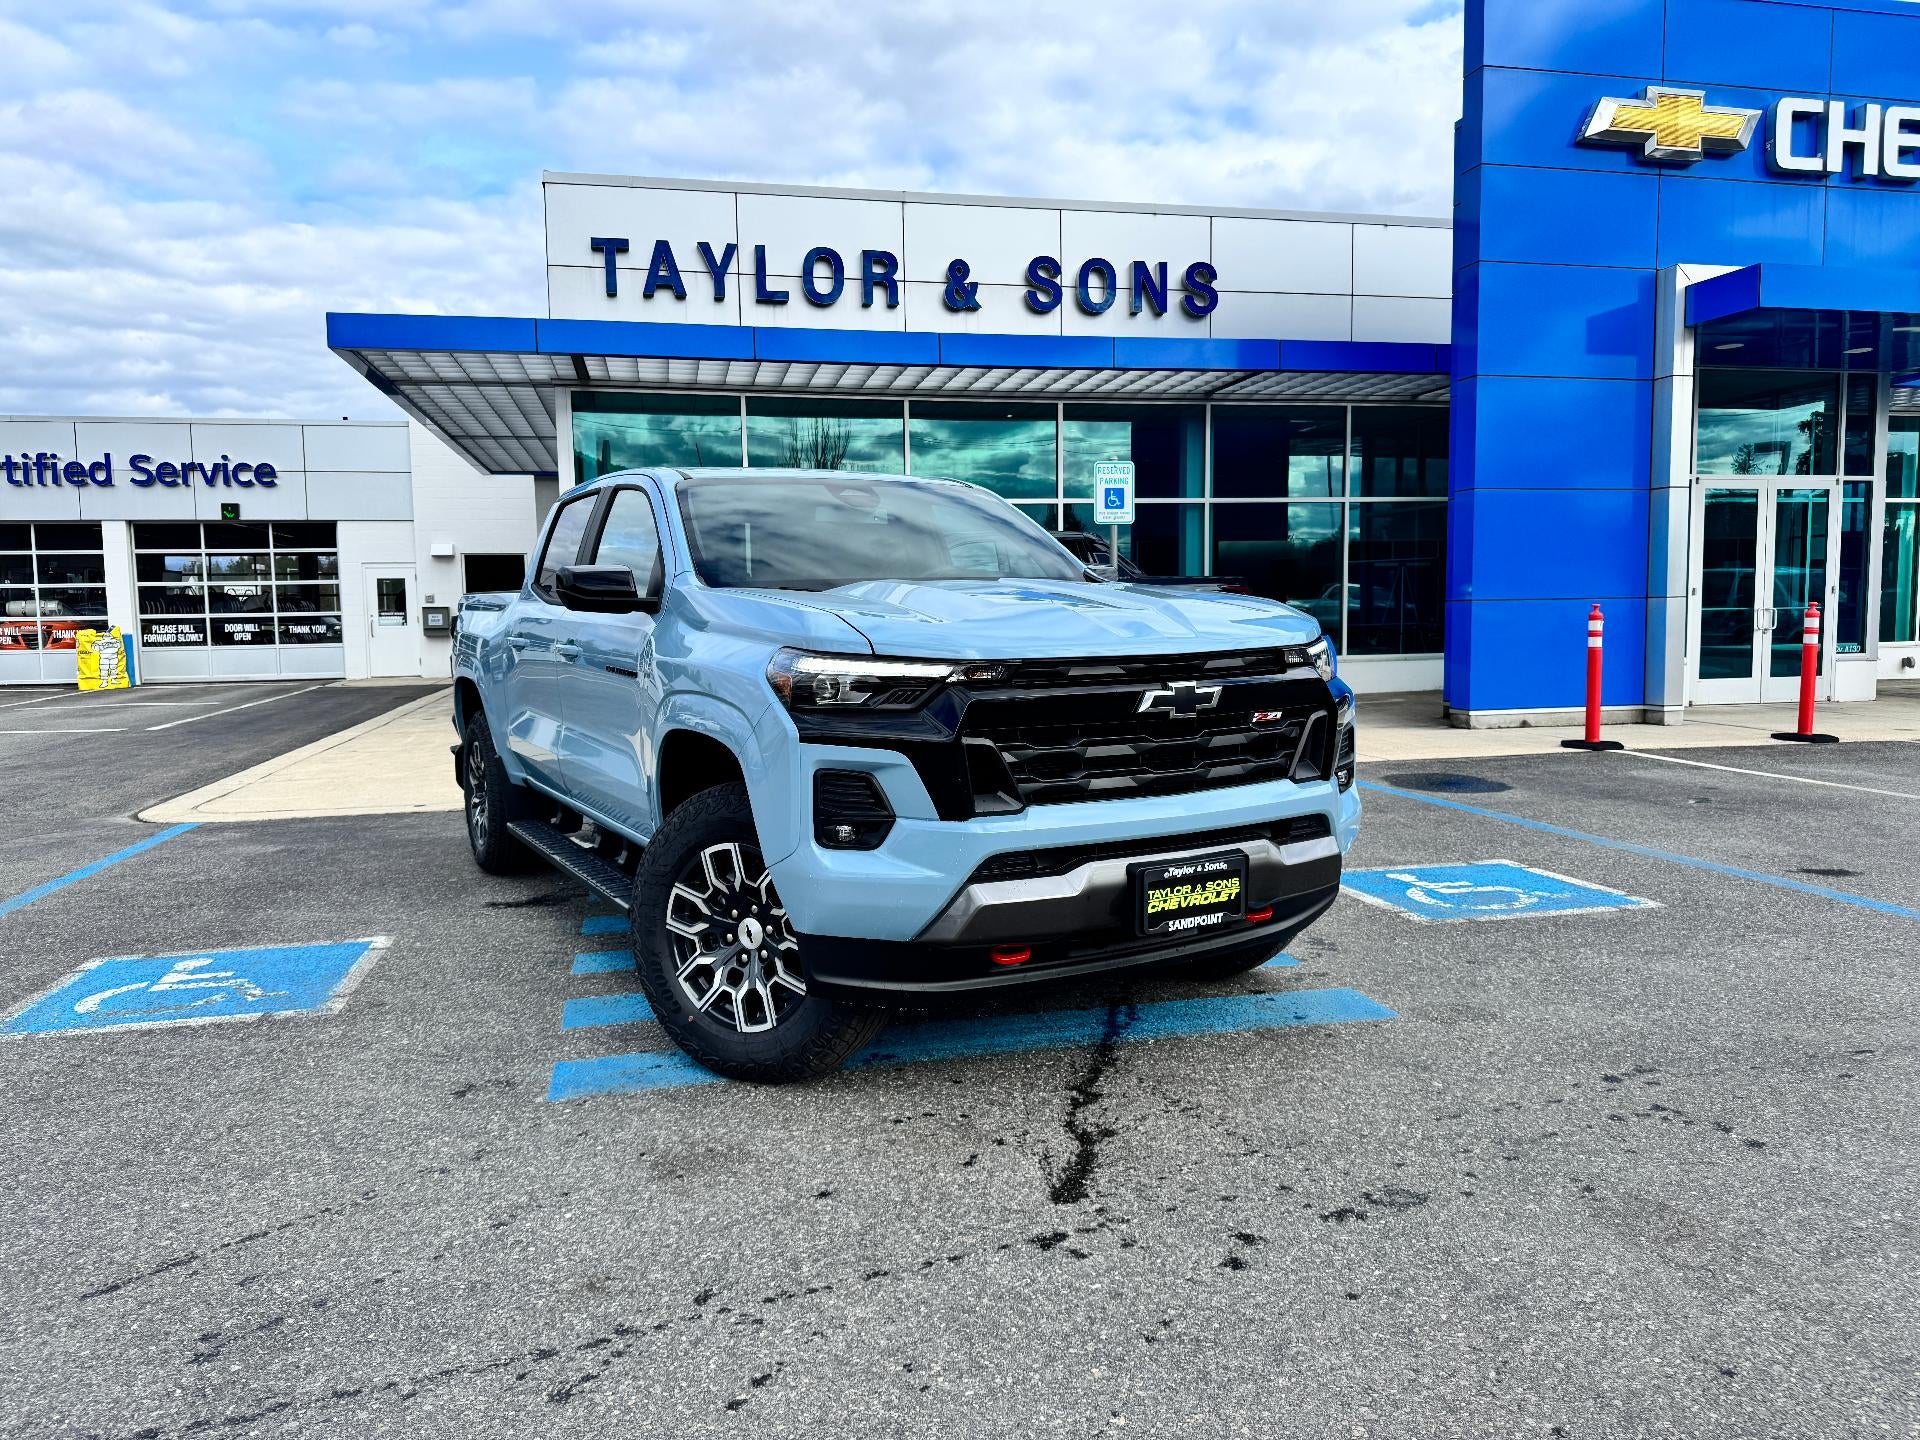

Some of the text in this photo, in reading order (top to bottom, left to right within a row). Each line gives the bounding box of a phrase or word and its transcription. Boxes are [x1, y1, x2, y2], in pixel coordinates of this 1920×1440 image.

[1775, 97, 1920, 177] CHE
[591, 237, 1219, 317] TAYLOR & SONS
[1, 453, 278, 488] tified Service
[1097, 466, 1130, 475] RESERVED
[1099, 477, 1129, 485] PARKING
[152, 624, 195, 634] PLEASE PULL
[225, 623, 260, 633] DOOR WILL
[289, 624, 327, 634] THANK YOU!
[52, 629, 76, 639] THANK
[144, 633, 203, 643] FORWARD SLOWLY
[234, 632, 252, 641] OPEN
[1168, 866, 1196, 878] Taylor
[1203, 861, 1224, 872] Sons
[1148, 878, 1239, 899] TAYLOR & SONS
[1148, 889, 1240, 913] CHEVROLET
[1168, 913, 1224, 931] SANDPOINT
